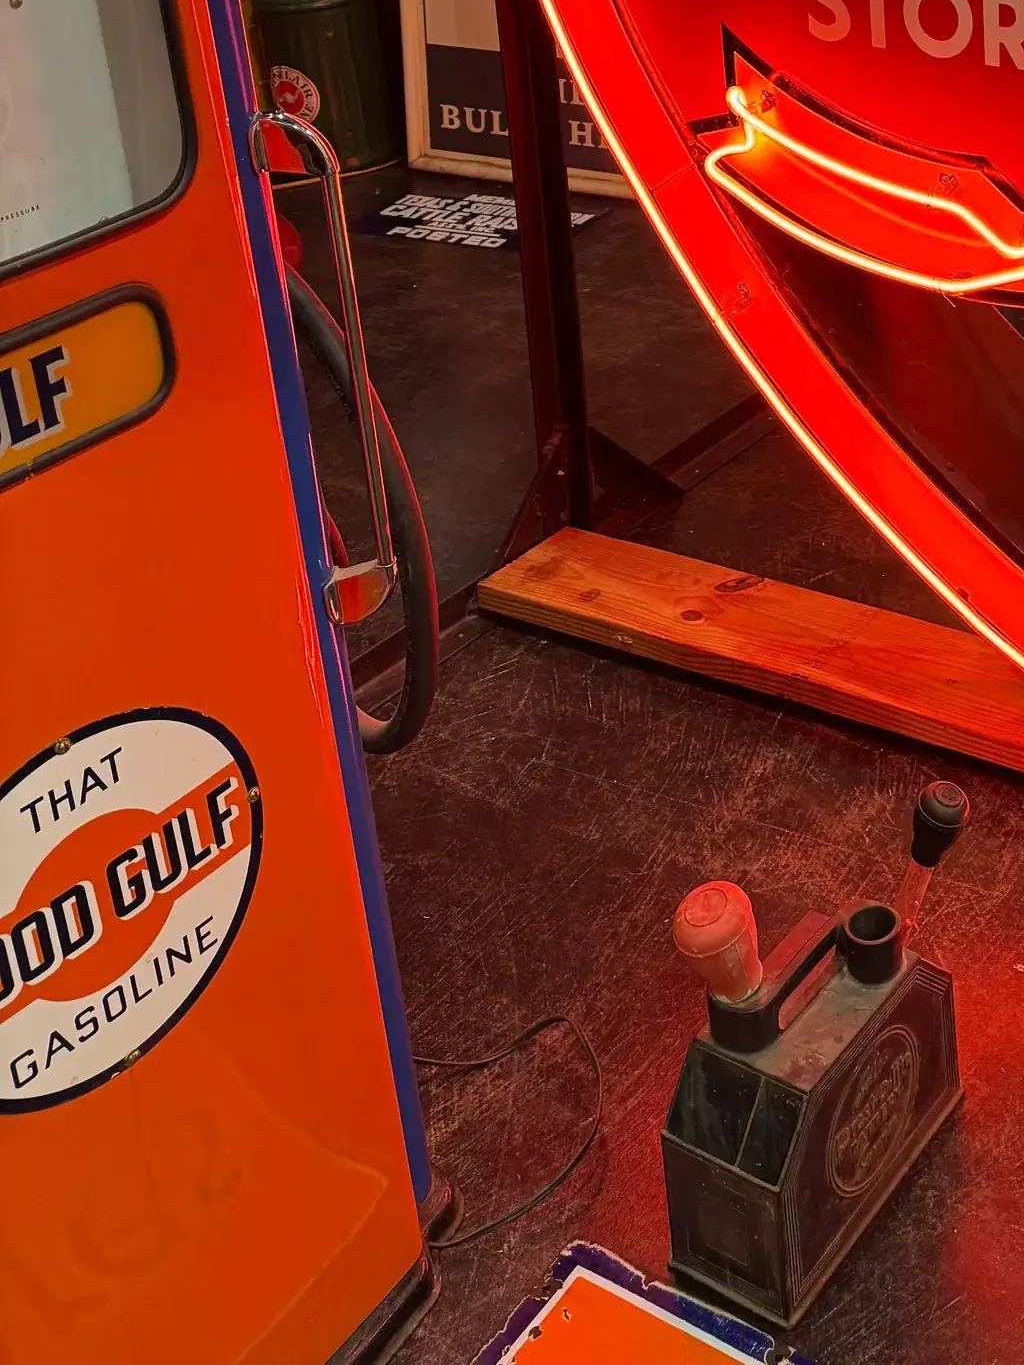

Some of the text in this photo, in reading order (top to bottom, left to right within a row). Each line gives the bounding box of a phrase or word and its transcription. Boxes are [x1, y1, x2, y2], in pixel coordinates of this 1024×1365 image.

[440, 104, 510, 136] BUL
[380, 204, 470, 223] CATTLE
[386, 226, 507, 248] POSTED
[20, 746, 122, 834] THAT
[105, 777, 240, 920] GULF
[10, 915, 218, 1089] GASOLINE
